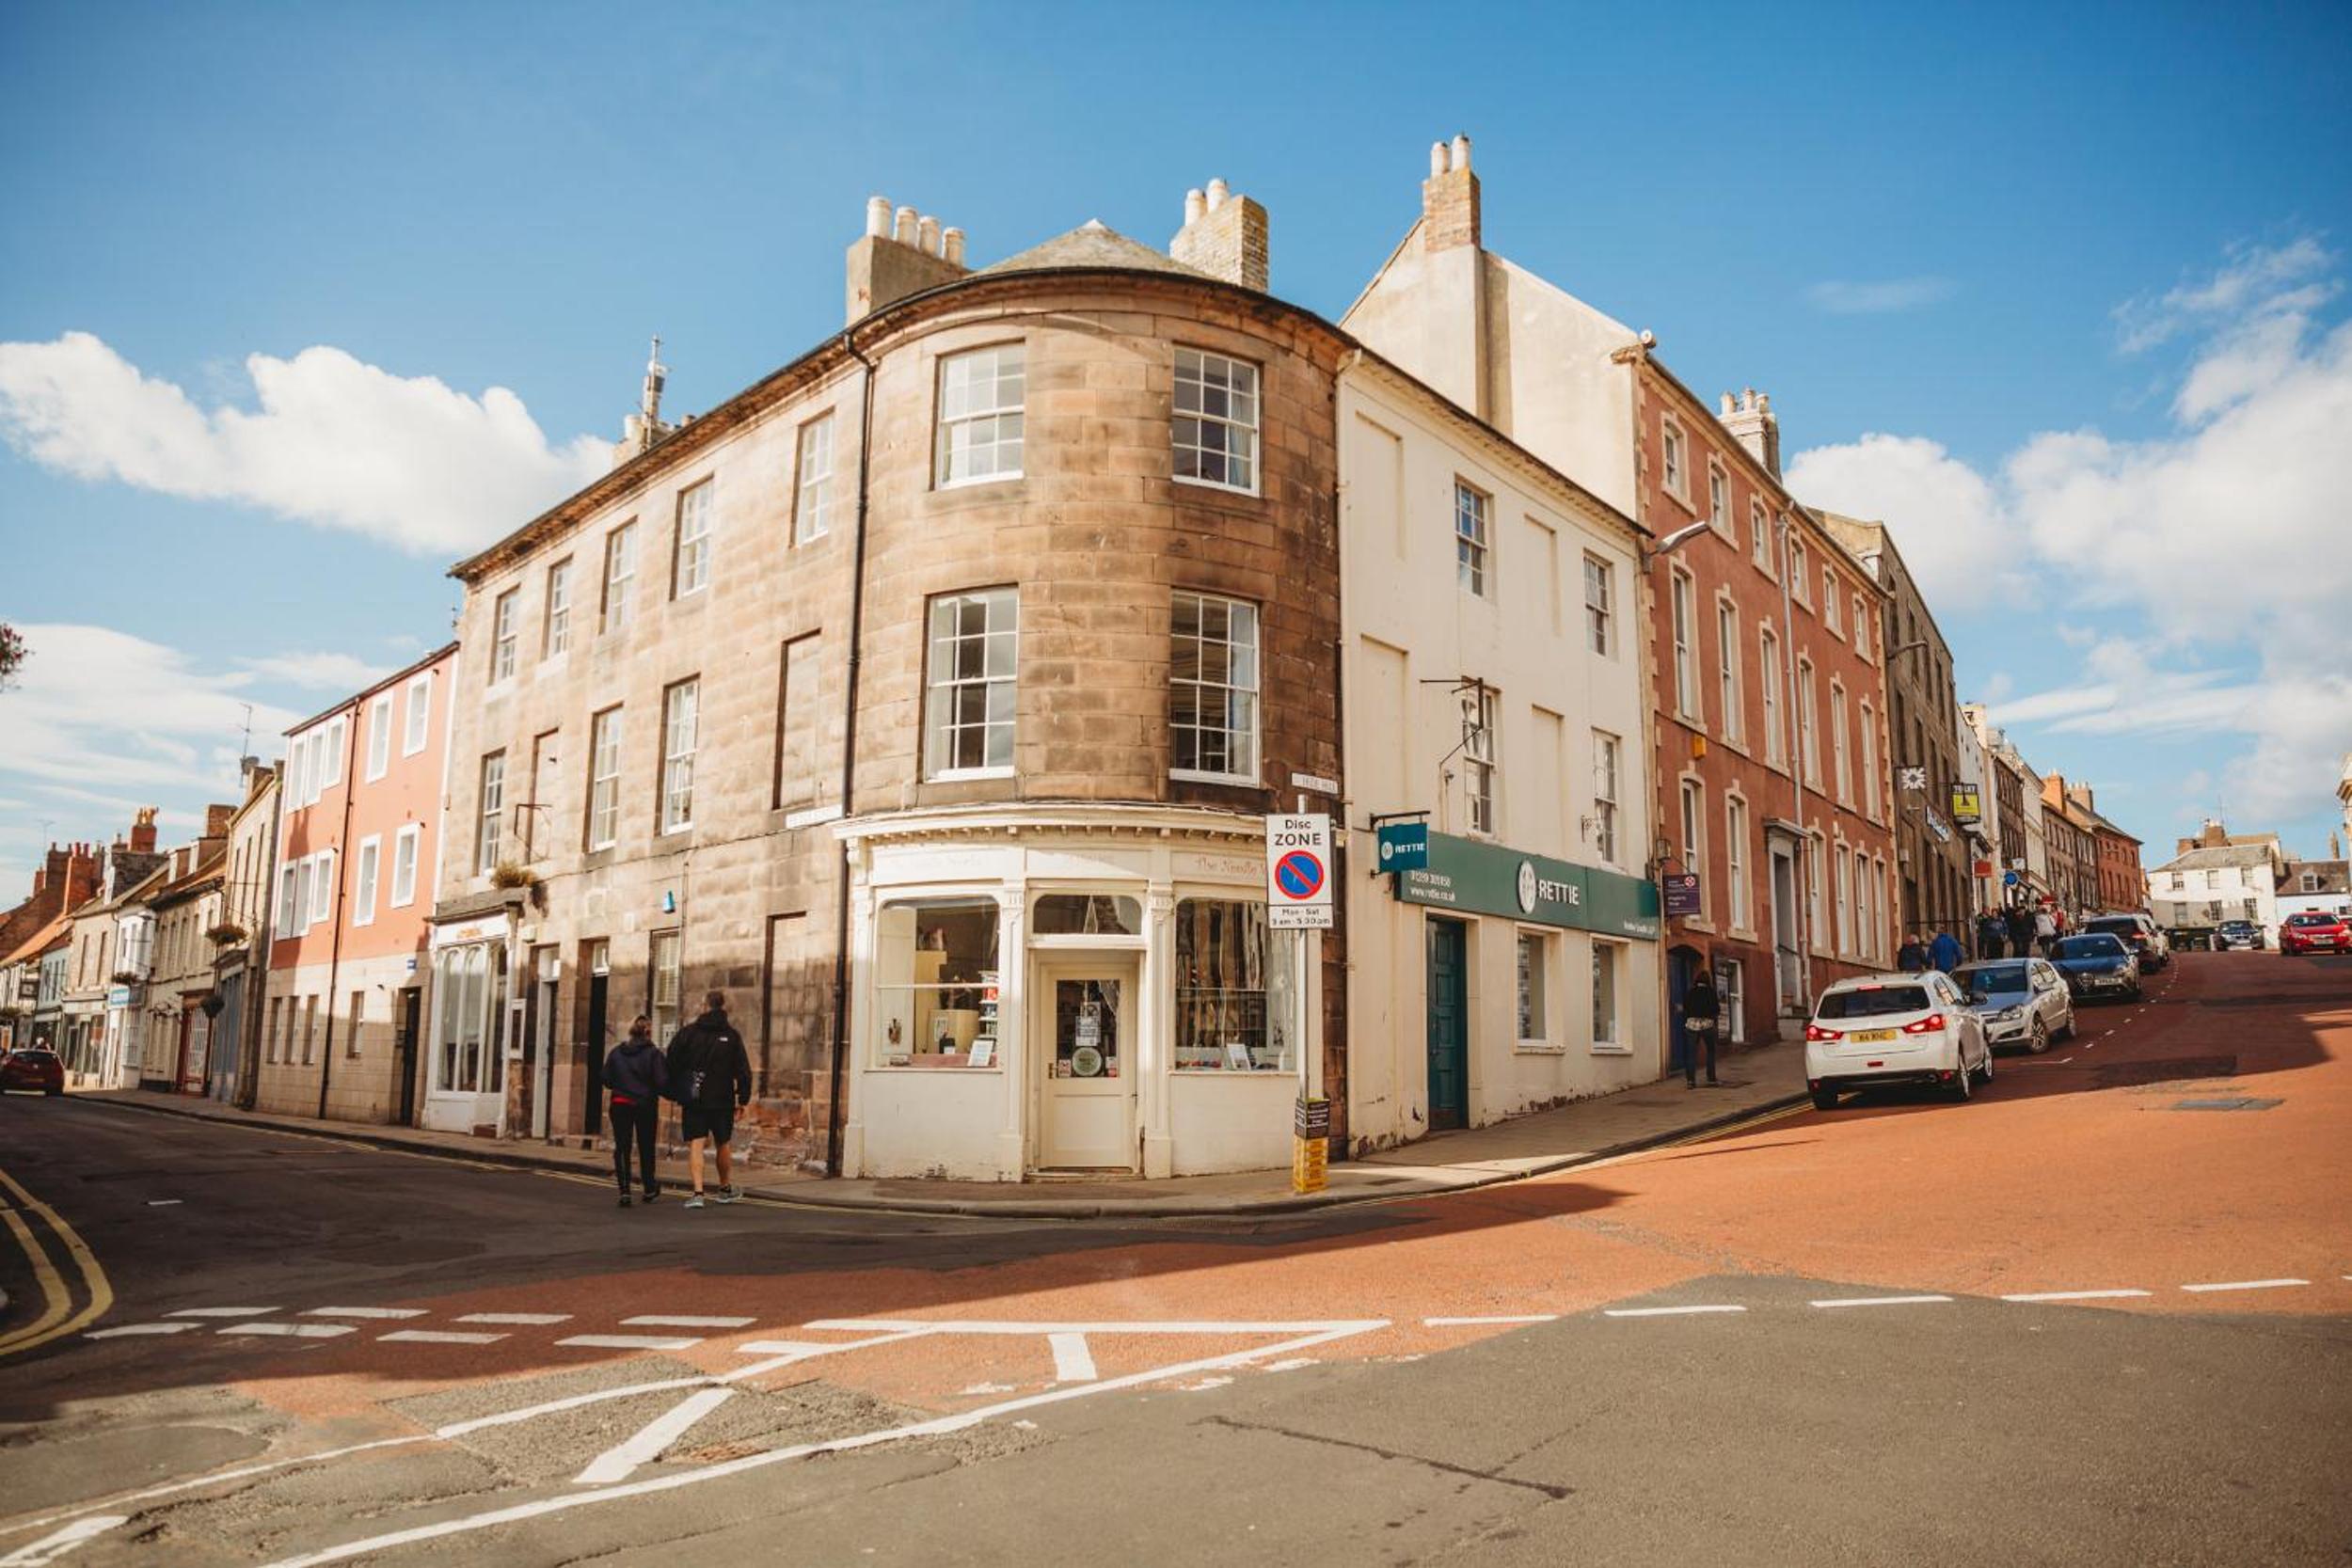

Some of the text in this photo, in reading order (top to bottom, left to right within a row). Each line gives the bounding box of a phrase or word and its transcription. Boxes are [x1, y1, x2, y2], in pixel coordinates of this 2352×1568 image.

[1285, 819, 1311, 829] Disc
[1274, 832, 1322, 846] ZONE
[1538, 879, 1580, 905] RETTIE
